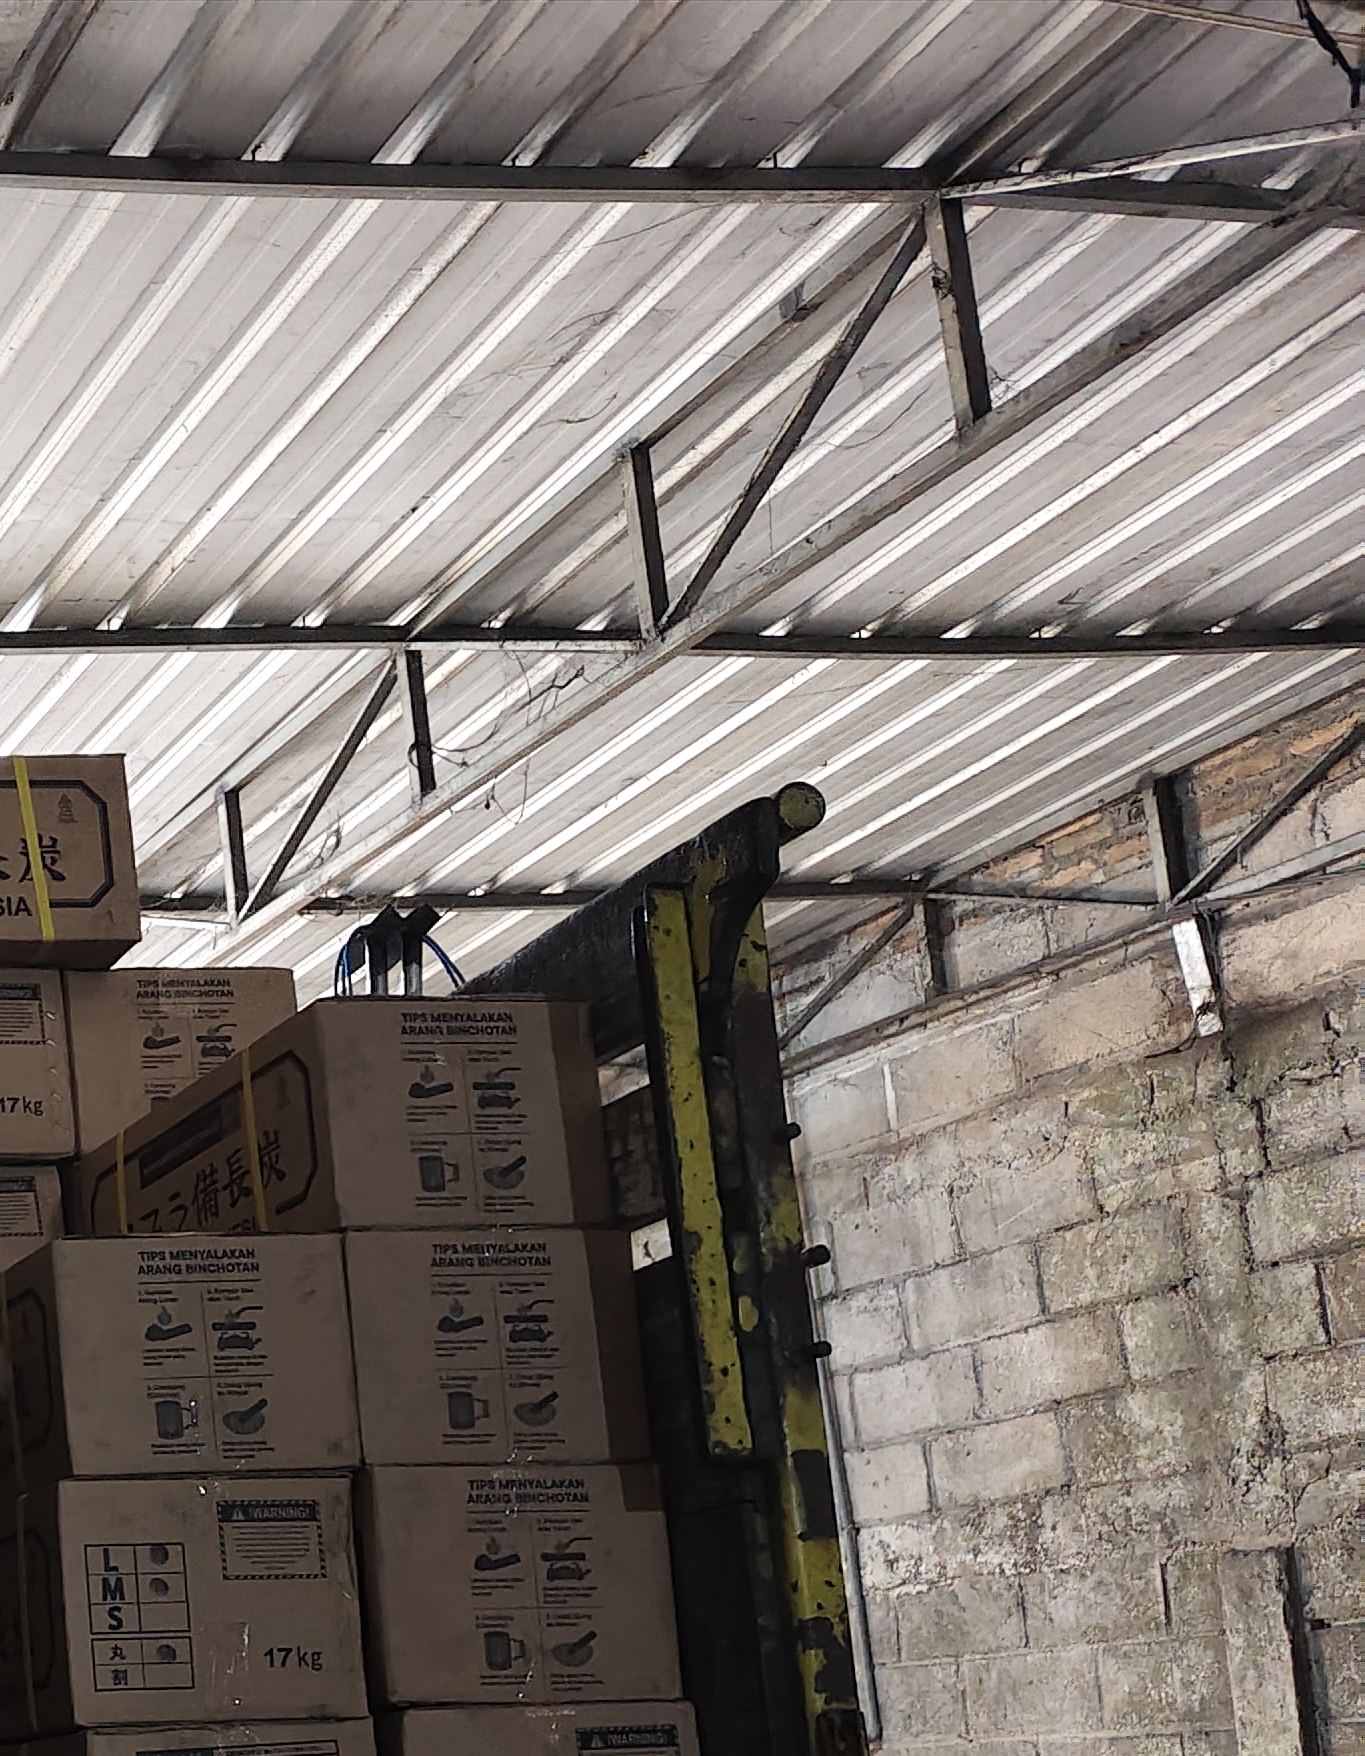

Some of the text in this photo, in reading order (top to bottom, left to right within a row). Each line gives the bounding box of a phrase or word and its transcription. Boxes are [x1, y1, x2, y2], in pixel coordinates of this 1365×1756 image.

[138, 1251, 166, 1262] TIPS
[138, 1264, 181, 1276] ARANG
[103, 1548, 118, 1572] L
[102, 1577, 125, 1601] M
[108, 1607, 123, 1630] S
